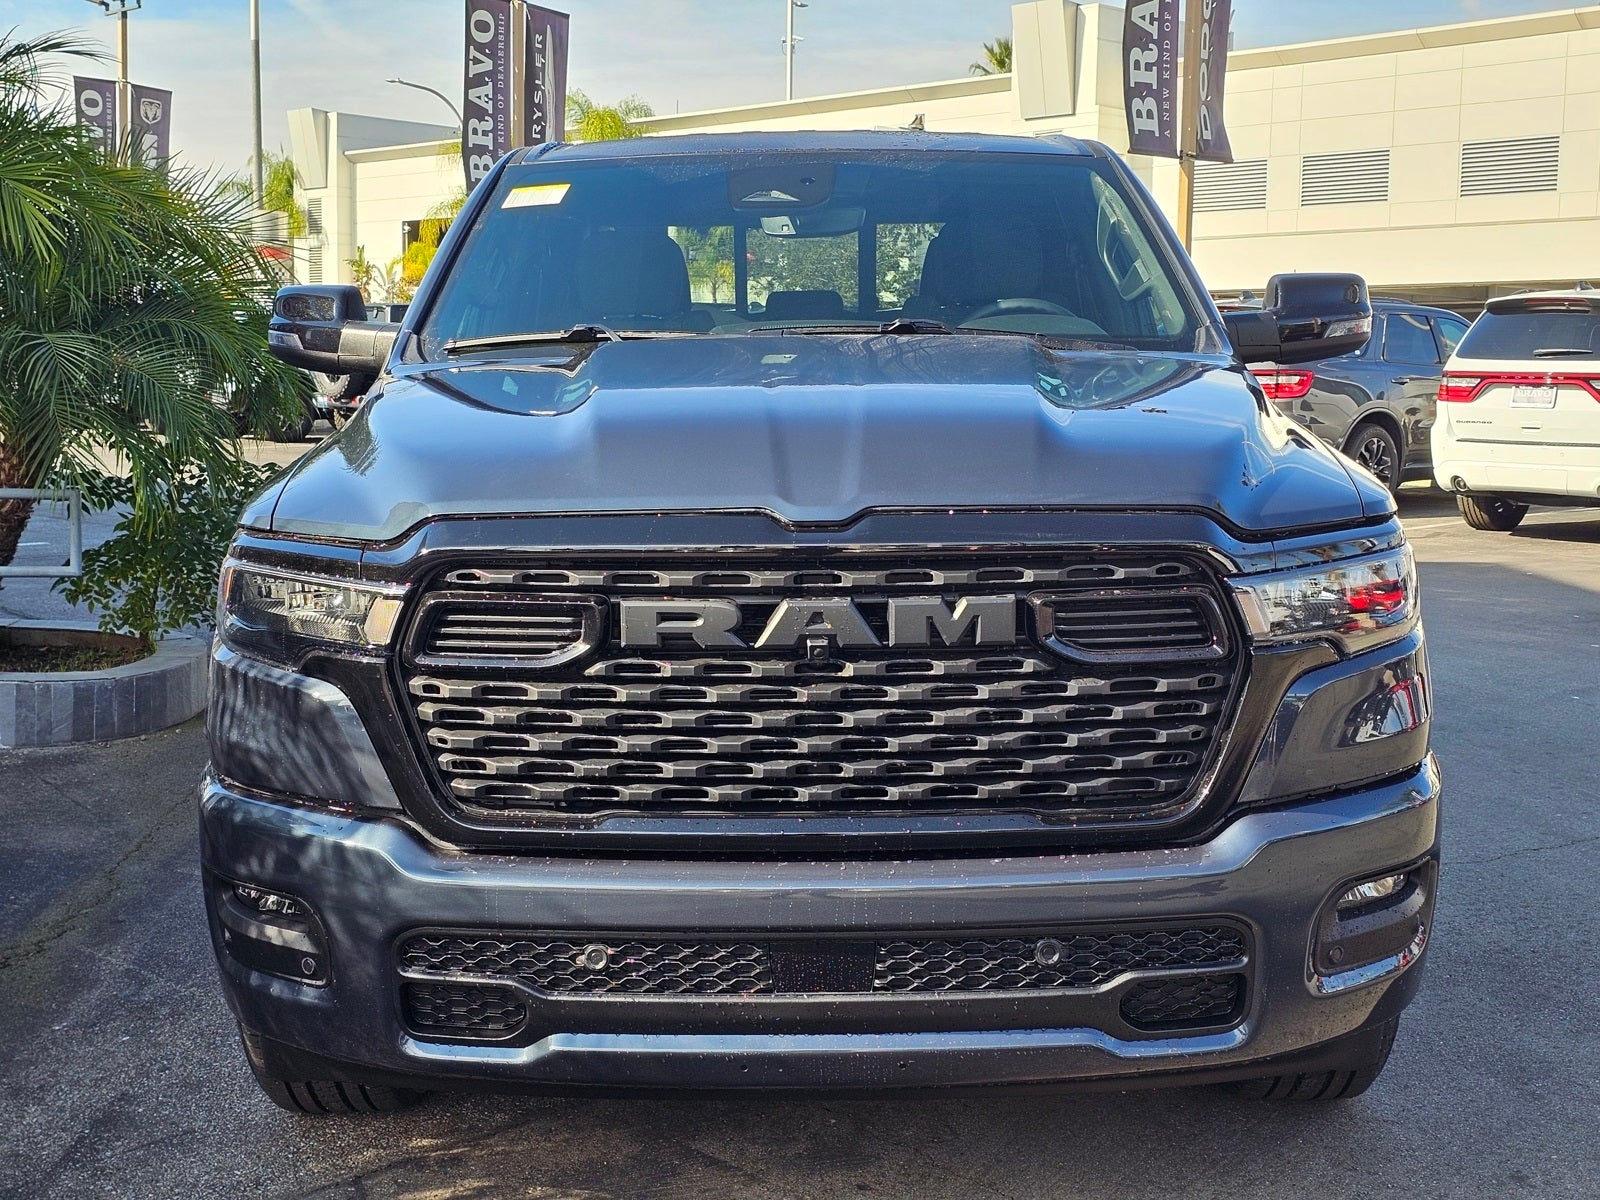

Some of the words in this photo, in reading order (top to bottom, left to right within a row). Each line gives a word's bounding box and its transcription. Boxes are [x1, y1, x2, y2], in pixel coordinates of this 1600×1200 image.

[1163, 11, 1172, 32] OF
[497, 13, 505, 89] DEALERSHIP
[1129, 0, 1159, 137] BRA
[1163, 40, 1171, 80] KIND
[1199, 0, 1212, 140] DODG
[468, 9, 495, 183] BRAVO
[497, 94, 505, 109] OF
[532, 33, 543, 139] RYSLER
[497, 114, 505, 143] KIND
[1164, 129, 1171, 138] A
[620, 594, 1017, 648] RAM
